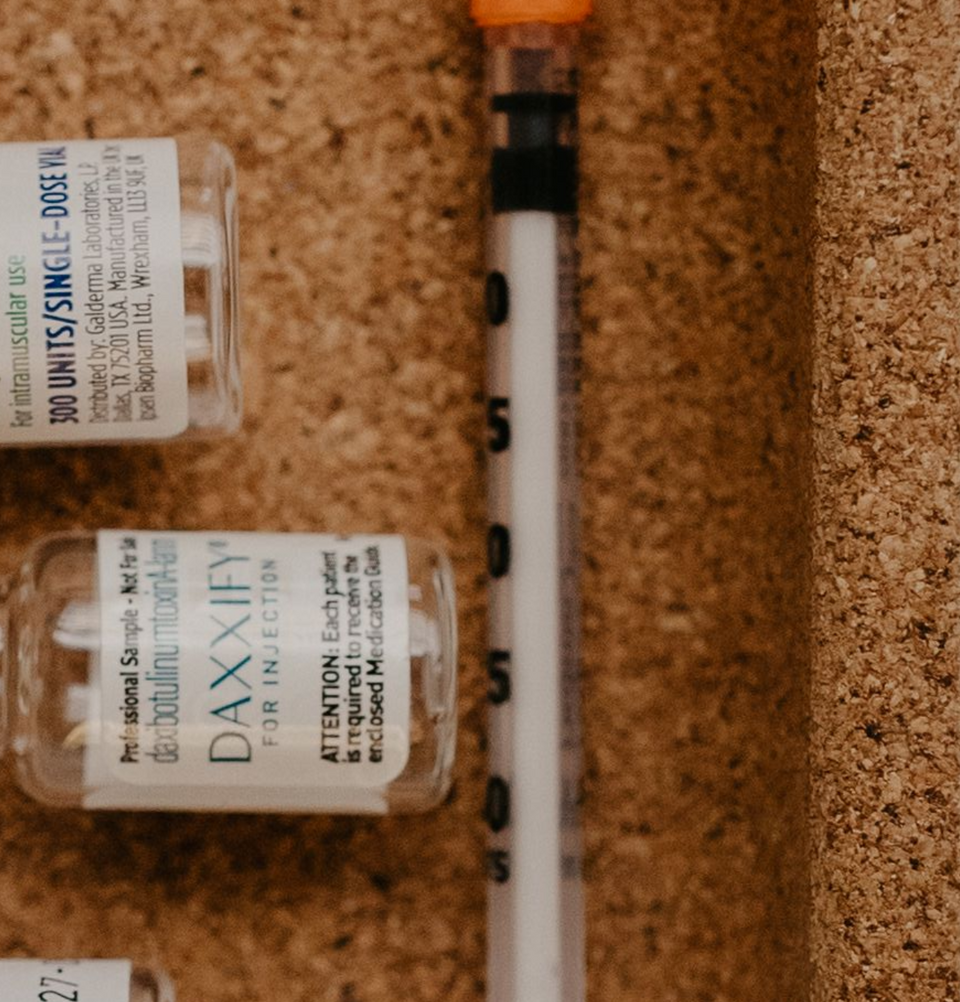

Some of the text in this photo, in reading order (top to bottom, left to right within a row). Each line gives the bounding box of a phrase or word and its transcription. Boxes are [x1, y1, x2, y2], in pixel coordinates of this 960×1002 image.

[102, 183, 123, 194] in
[103, 197, 127, 291] Manufactured
[128, 216, 152, 289] Wrexham,
[39, 173, 78, 388] UNITS/SINGLE-DOSE
[85, 263, 106, 335] Galderma
[107, 296, 129, 329] USA.
[5, 255, 34, 427] For intramuscular use
[86, 338, 111, 360] by:
[109, 333, 131, 370] 75201
[134, 329, 158, 392] Biopharm
[49, 395, 79, 424] 300
[110, 373, 131, 387] TX
[120, 609, 142, 666] Sample
[260, 558, 280, 747] FOR INJECTION
[321, 600, 339, 642] Each
[344, 642, 361, 659] to
[364, 580, 384, 676] Medication
[119, 671, 139, 763] Professional
[321, 649, 341, 763] ATTENTION:
[344, 665, 365, 745] required
[366, 682, 384, 763] enclosed
[342, 750, 361, 763] is
